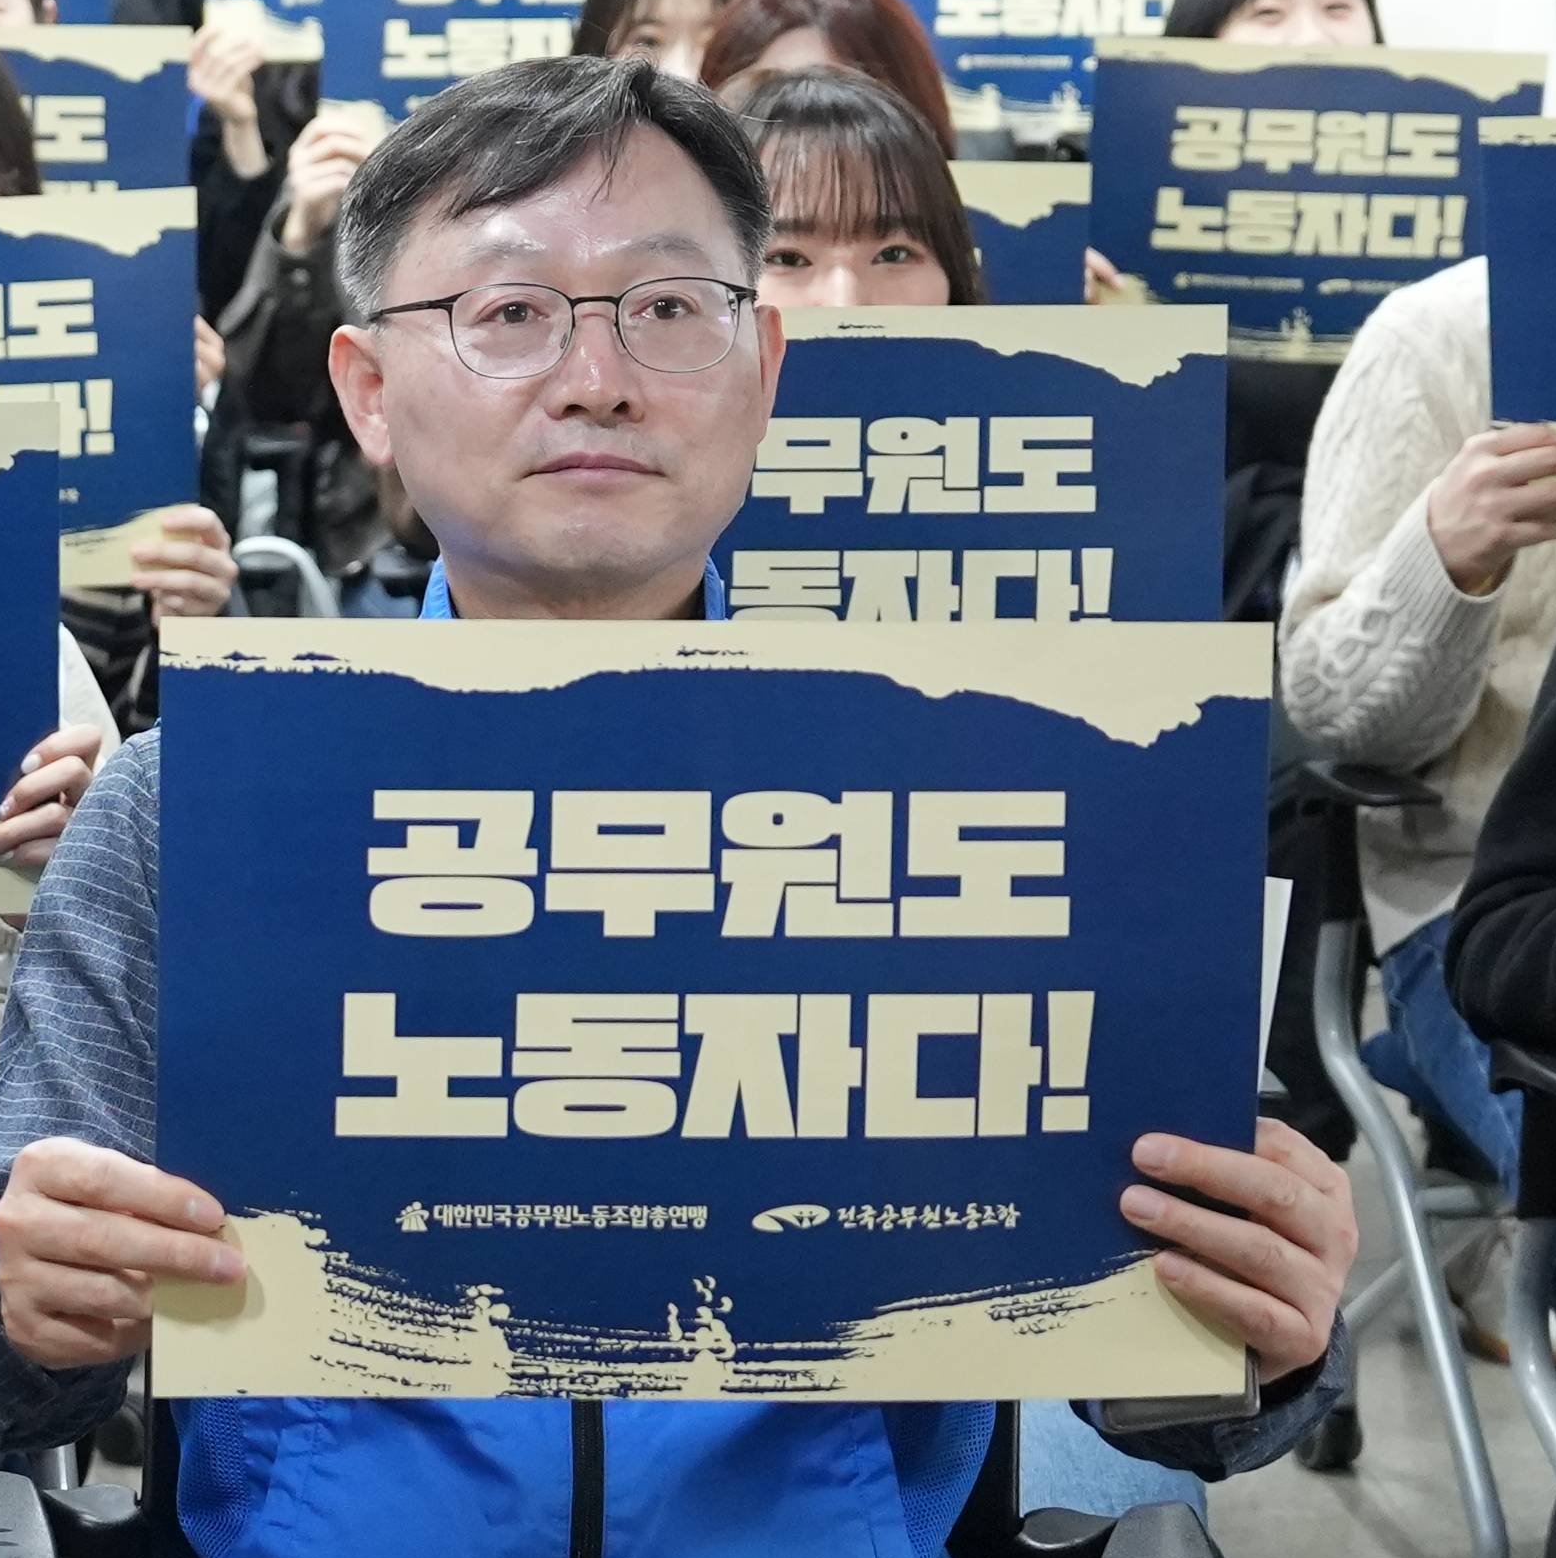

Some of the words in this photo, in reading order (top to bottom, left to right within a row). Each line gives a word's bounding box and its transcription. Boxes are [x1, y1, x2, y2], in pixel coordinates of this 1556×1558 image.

[1172, 106, 1461, 177] 공무원도
[1151, 187, 1467, 258] 노동자다!
[751, 416, 1097, 514] 무원도
[730, 547, 1114, 621] 동자다!
[368, 790, 1070, 937] 공무원도
[335, 991, 1094, 1138] 노동자다!
[433, 1204, 707, 1229] 대한민국공무원노동조합총연맹
[838, 1203, 1020, 1230] 전국공무원노동조합
